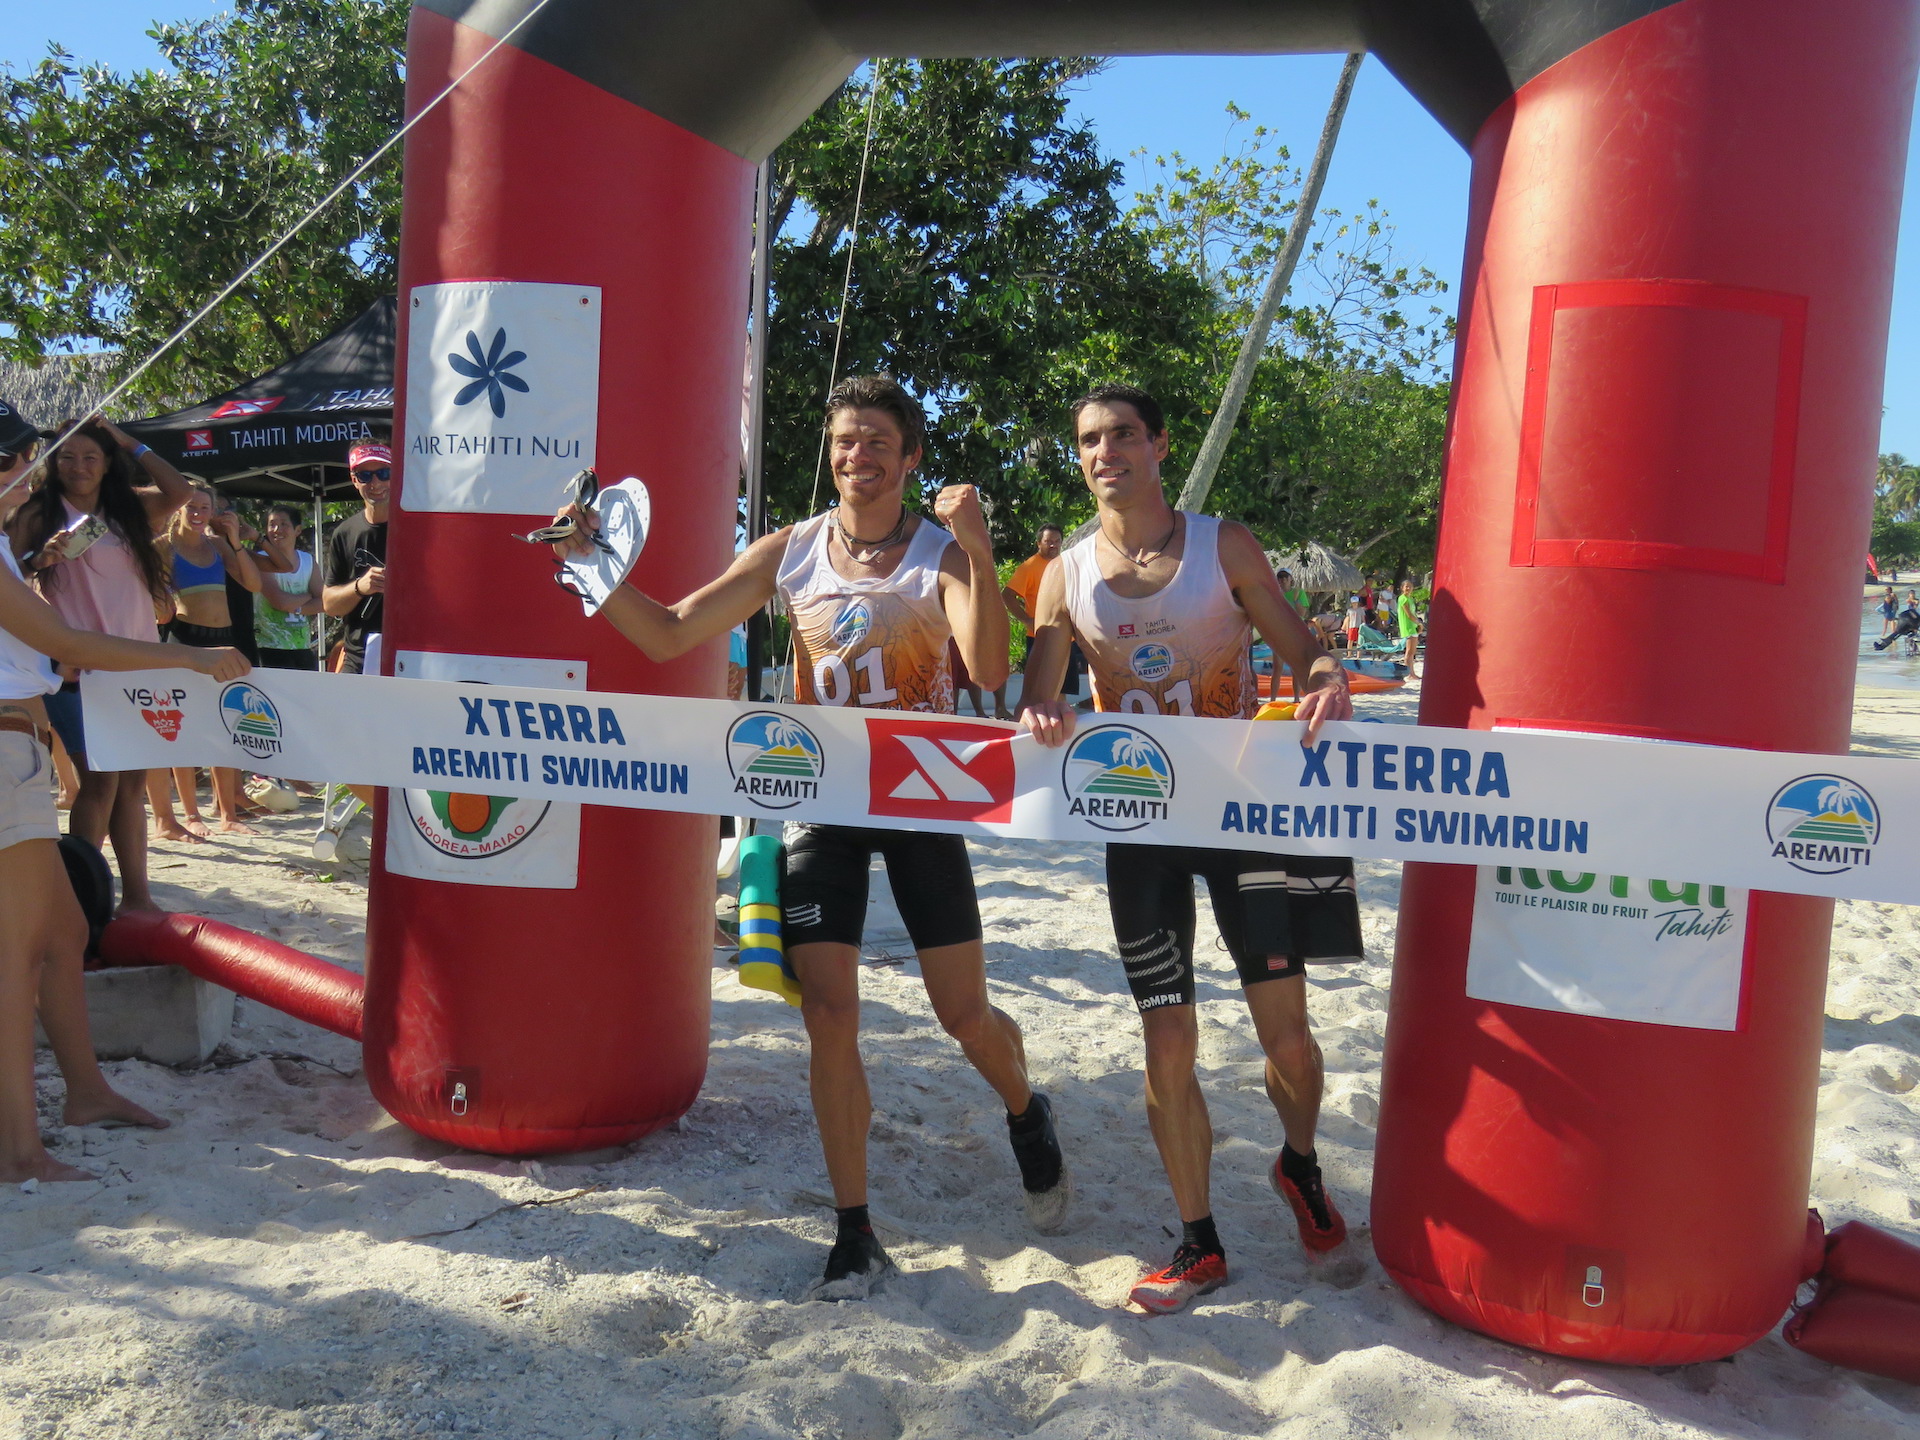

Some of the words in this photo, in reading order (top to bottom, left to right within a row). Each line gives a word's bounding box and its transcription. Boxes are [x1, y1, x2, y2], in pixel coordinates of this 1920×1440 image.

[230, 426, 287, 450] TAHITI
[296, 421, 373, 445] MOOREA
[412, 435, 443, 456] AIR
[446, 434, 521, 456] TAHITI
[532, 436, 579, 458] NUI
[1145, 619, 1167, 629] TAHITI
[1146, 625, 1176, 636] MOOREA
[813, 646, 898, 707] 01
[1138, 665, 1170, 677] AREMITI
[459, 697, 626, 745] XTERRA
[232, 732, 282, 753] AREMITI
[412, 747, 529, 782] AREMITI
[542, 755, 688, 794] SWIMRUN
[1299, 740, 1511, 798] XTERRA
[734, 776, 818, 799] AREMITI
[1068, 797, 1168, 820] AREMITI
[417, 815, 526, 854] MOOREA-MAIAO
[1221, 801, 1377, 840] AREMITI
[1395, 808, 1588, 854] SWIMRUN
[1771, 841, 1871, 866] AREMITI
[1495, 891, 1521, 905] TOUT
[1524, 895, 1537, 907] LE
[1541, 897, 1588, 914] PLAISIR
[1592, 904, 1609, 916] DU
[1612, 905, 1648, 920] FRUIT
[1654, 908, 1734, 942] Tahiti
